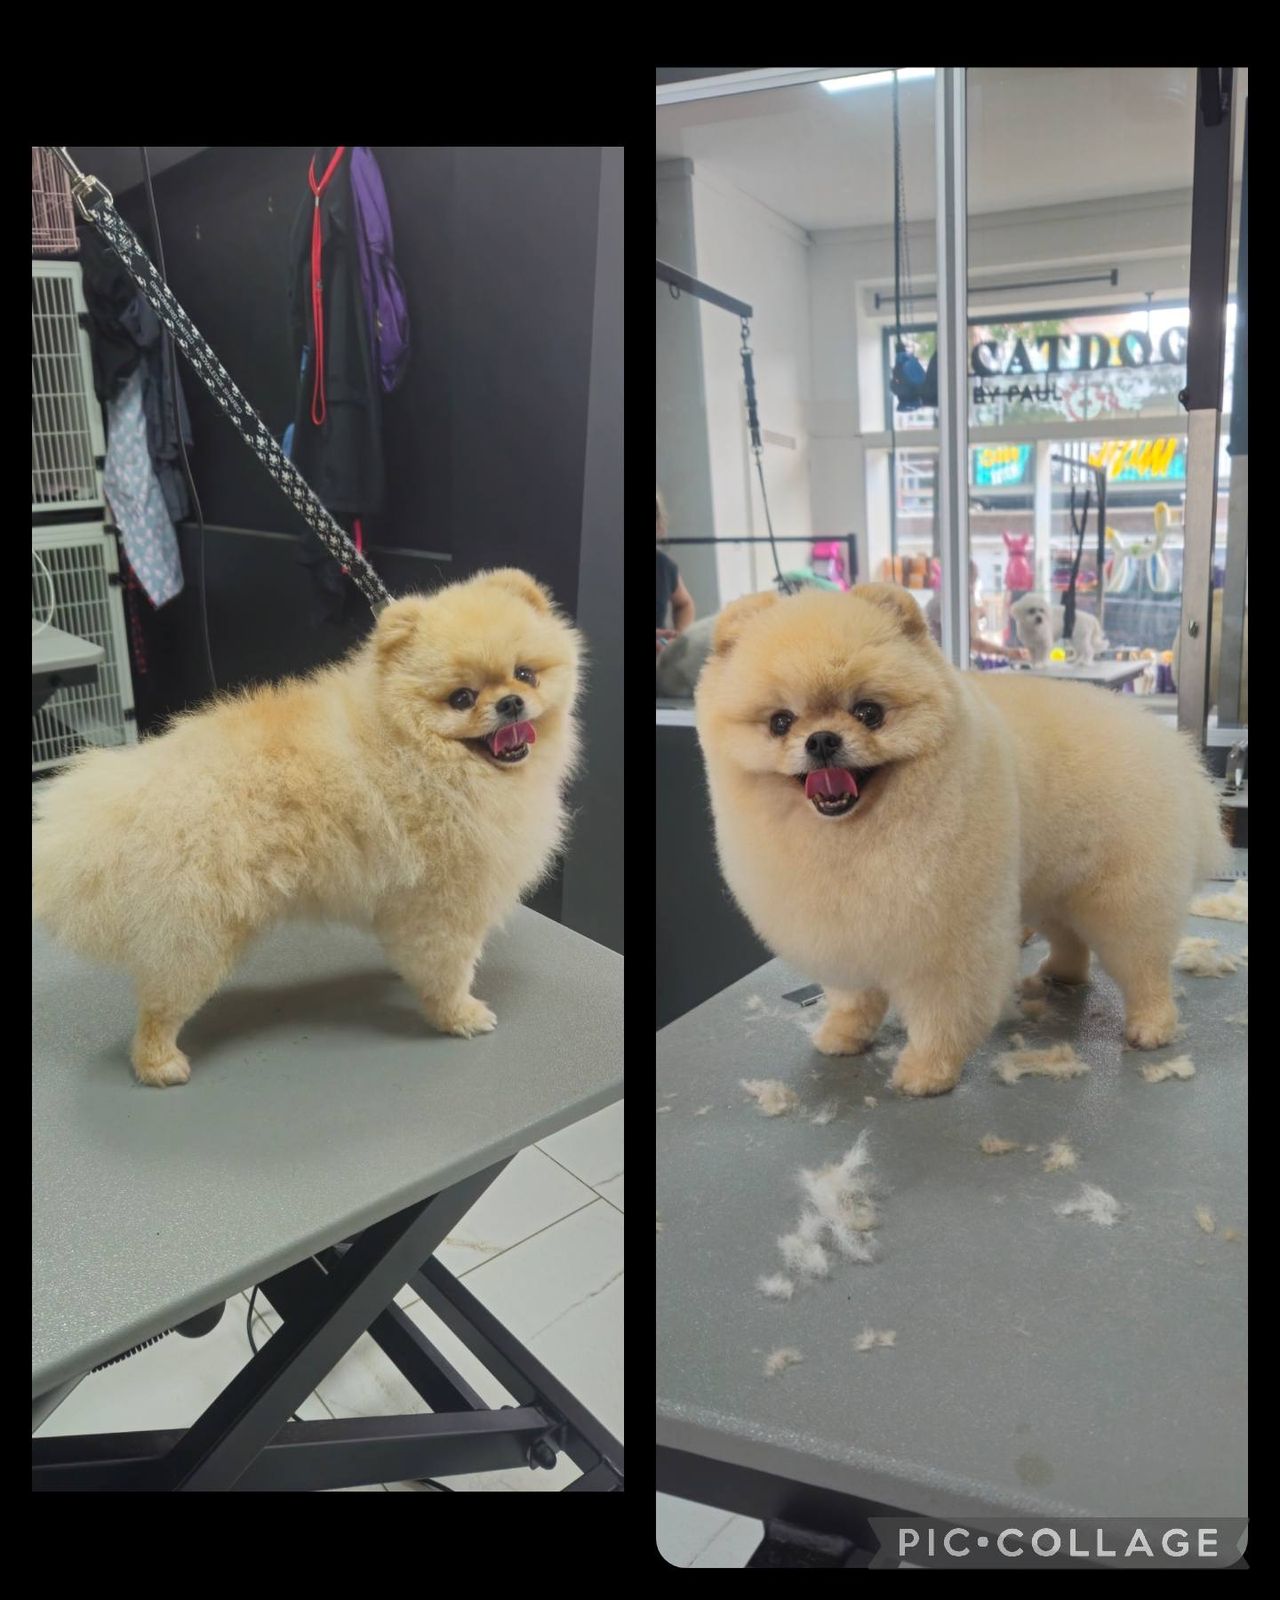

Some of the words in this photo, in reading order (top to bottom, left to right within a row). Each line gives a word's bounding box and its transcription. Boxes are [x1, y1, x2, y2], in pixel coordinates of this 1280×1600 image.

[176, 319, 195, 345] UNITED
[222, 386, 243, 414] SHARED
[973, 385, 1000, 404] BY
[1007, 382, 1062, 403] PAUL
